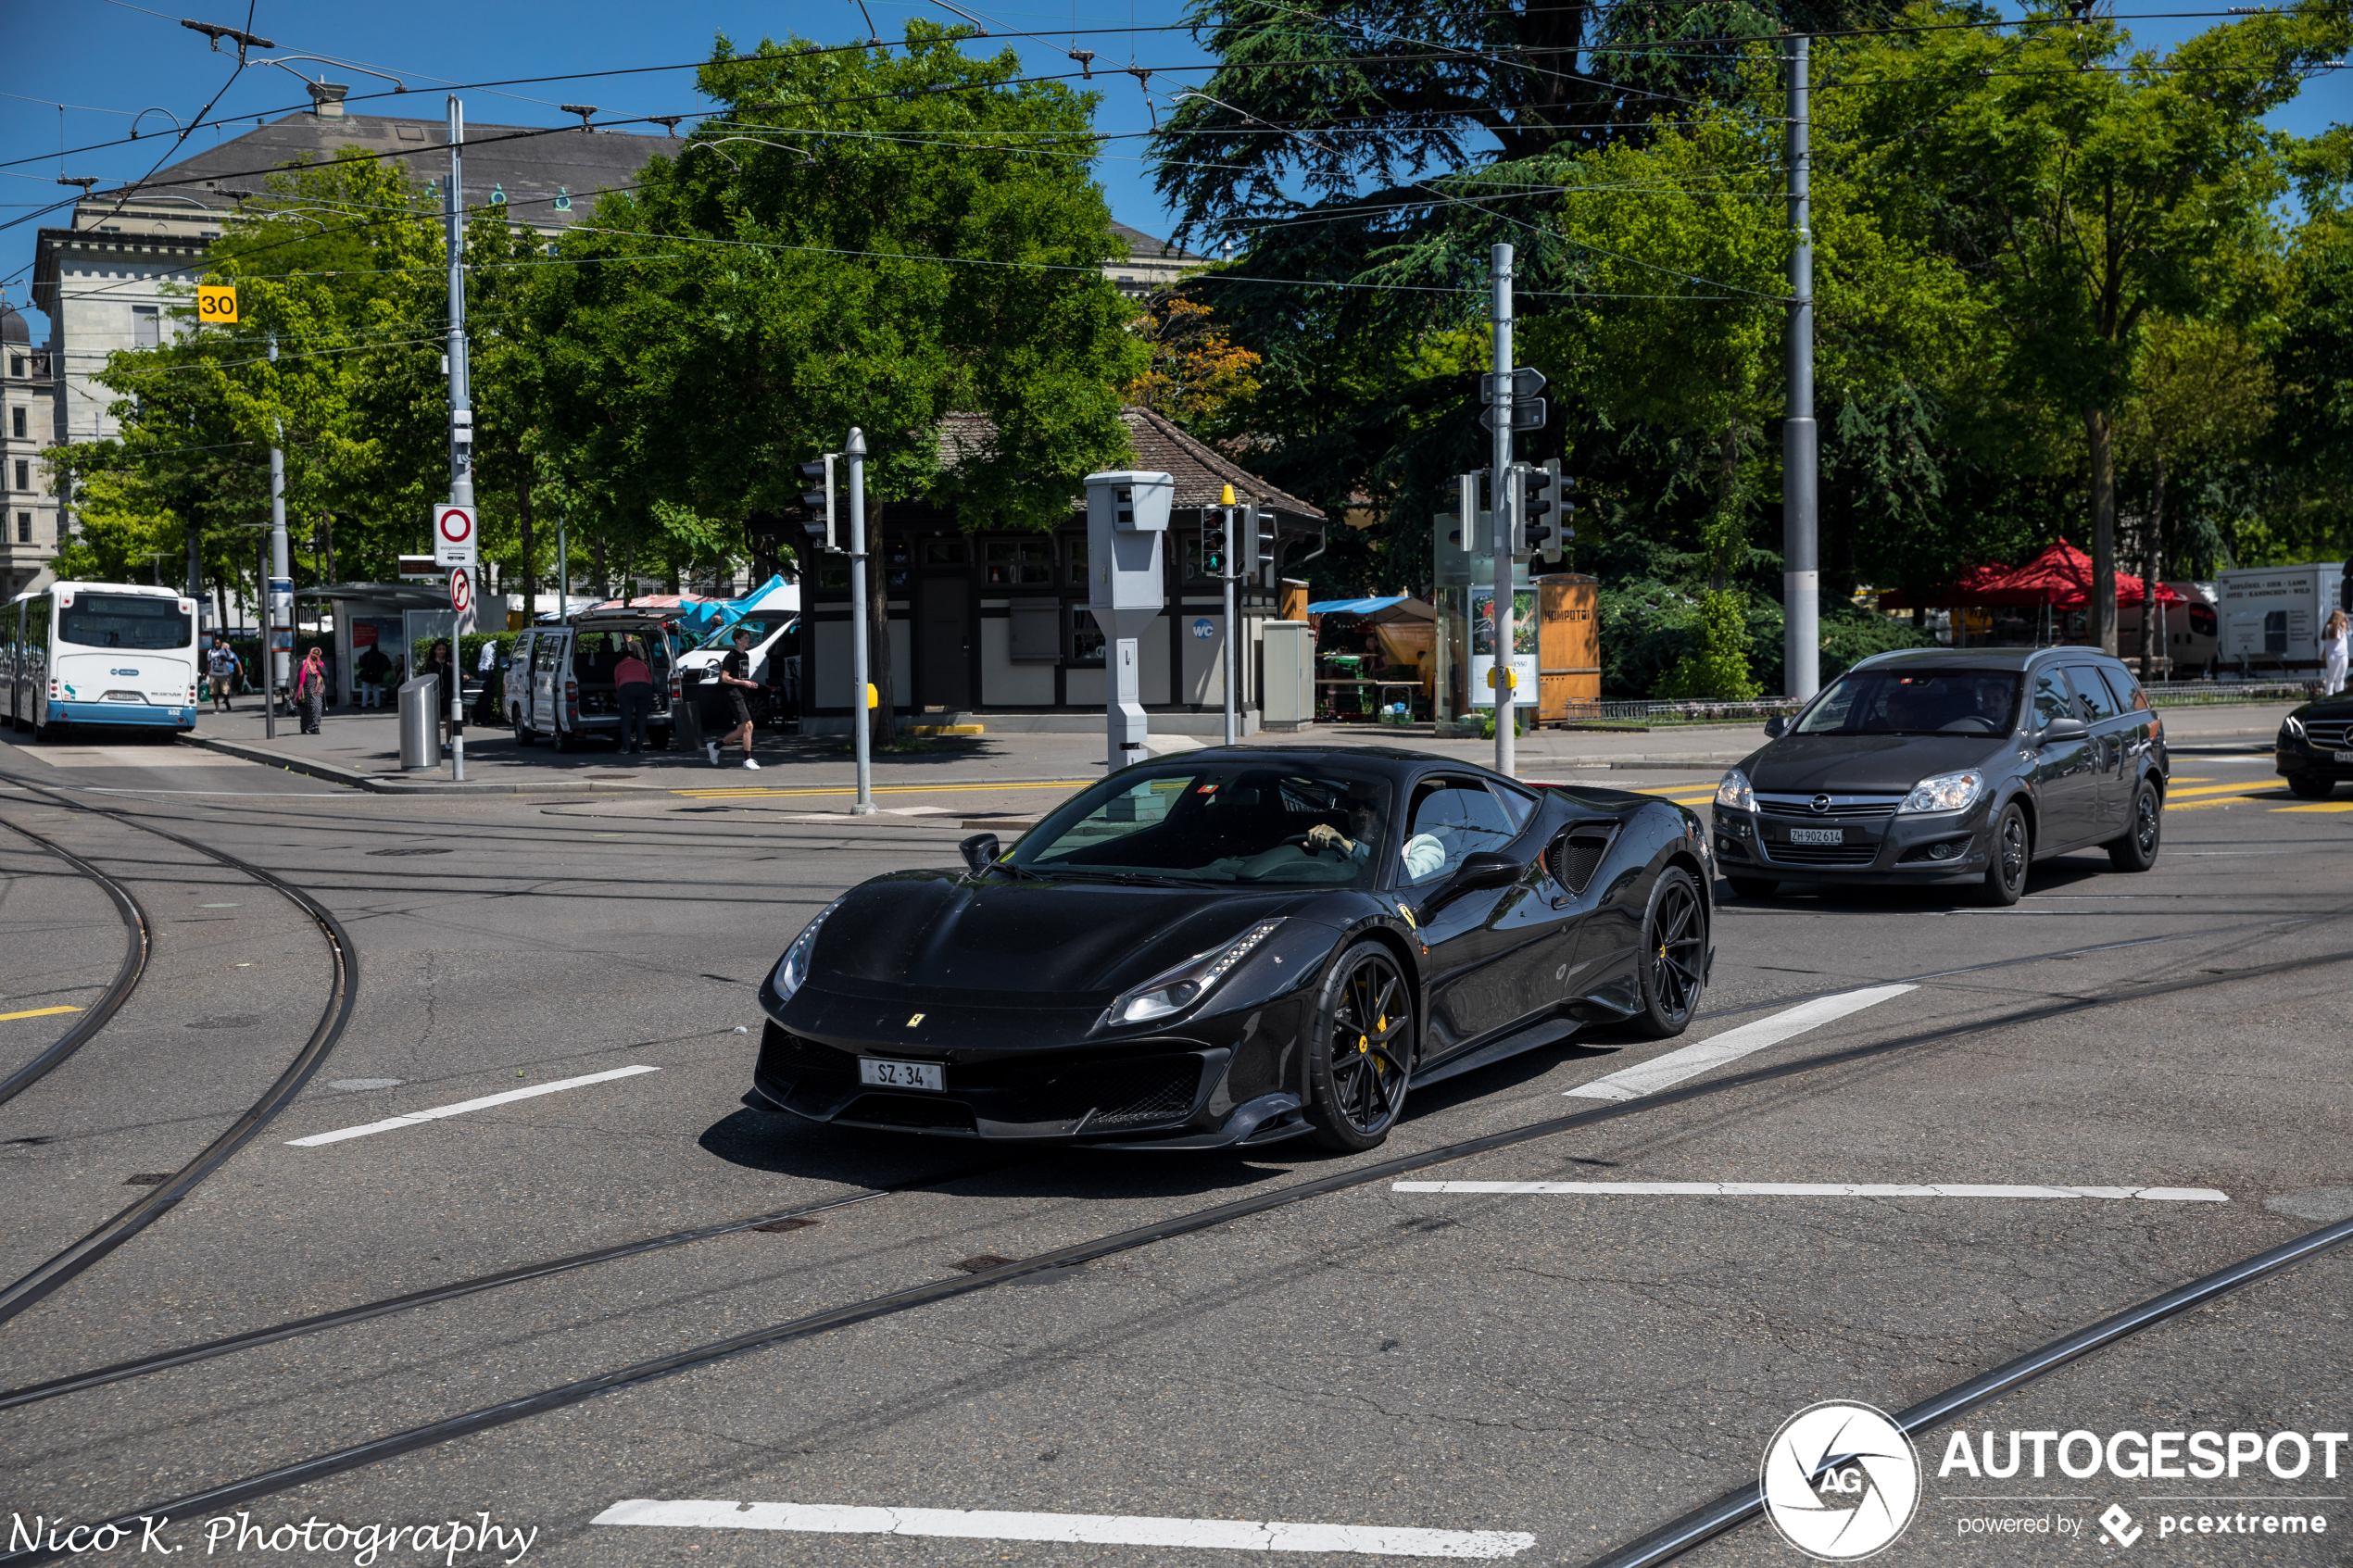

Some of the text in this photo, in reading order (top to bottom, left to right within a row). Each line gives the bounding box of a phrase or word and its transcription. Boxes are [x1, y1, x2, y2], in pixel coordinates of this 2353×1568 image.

[202, 295, 234, 315] 30
[2229, 582, 2260, 591] GEFLÜGEL
[2288, 579, 2308, 587] LAMM
[2249, 588, 2287, 598] KANINCHEN
[1193, 626, 1214, 637] WC
